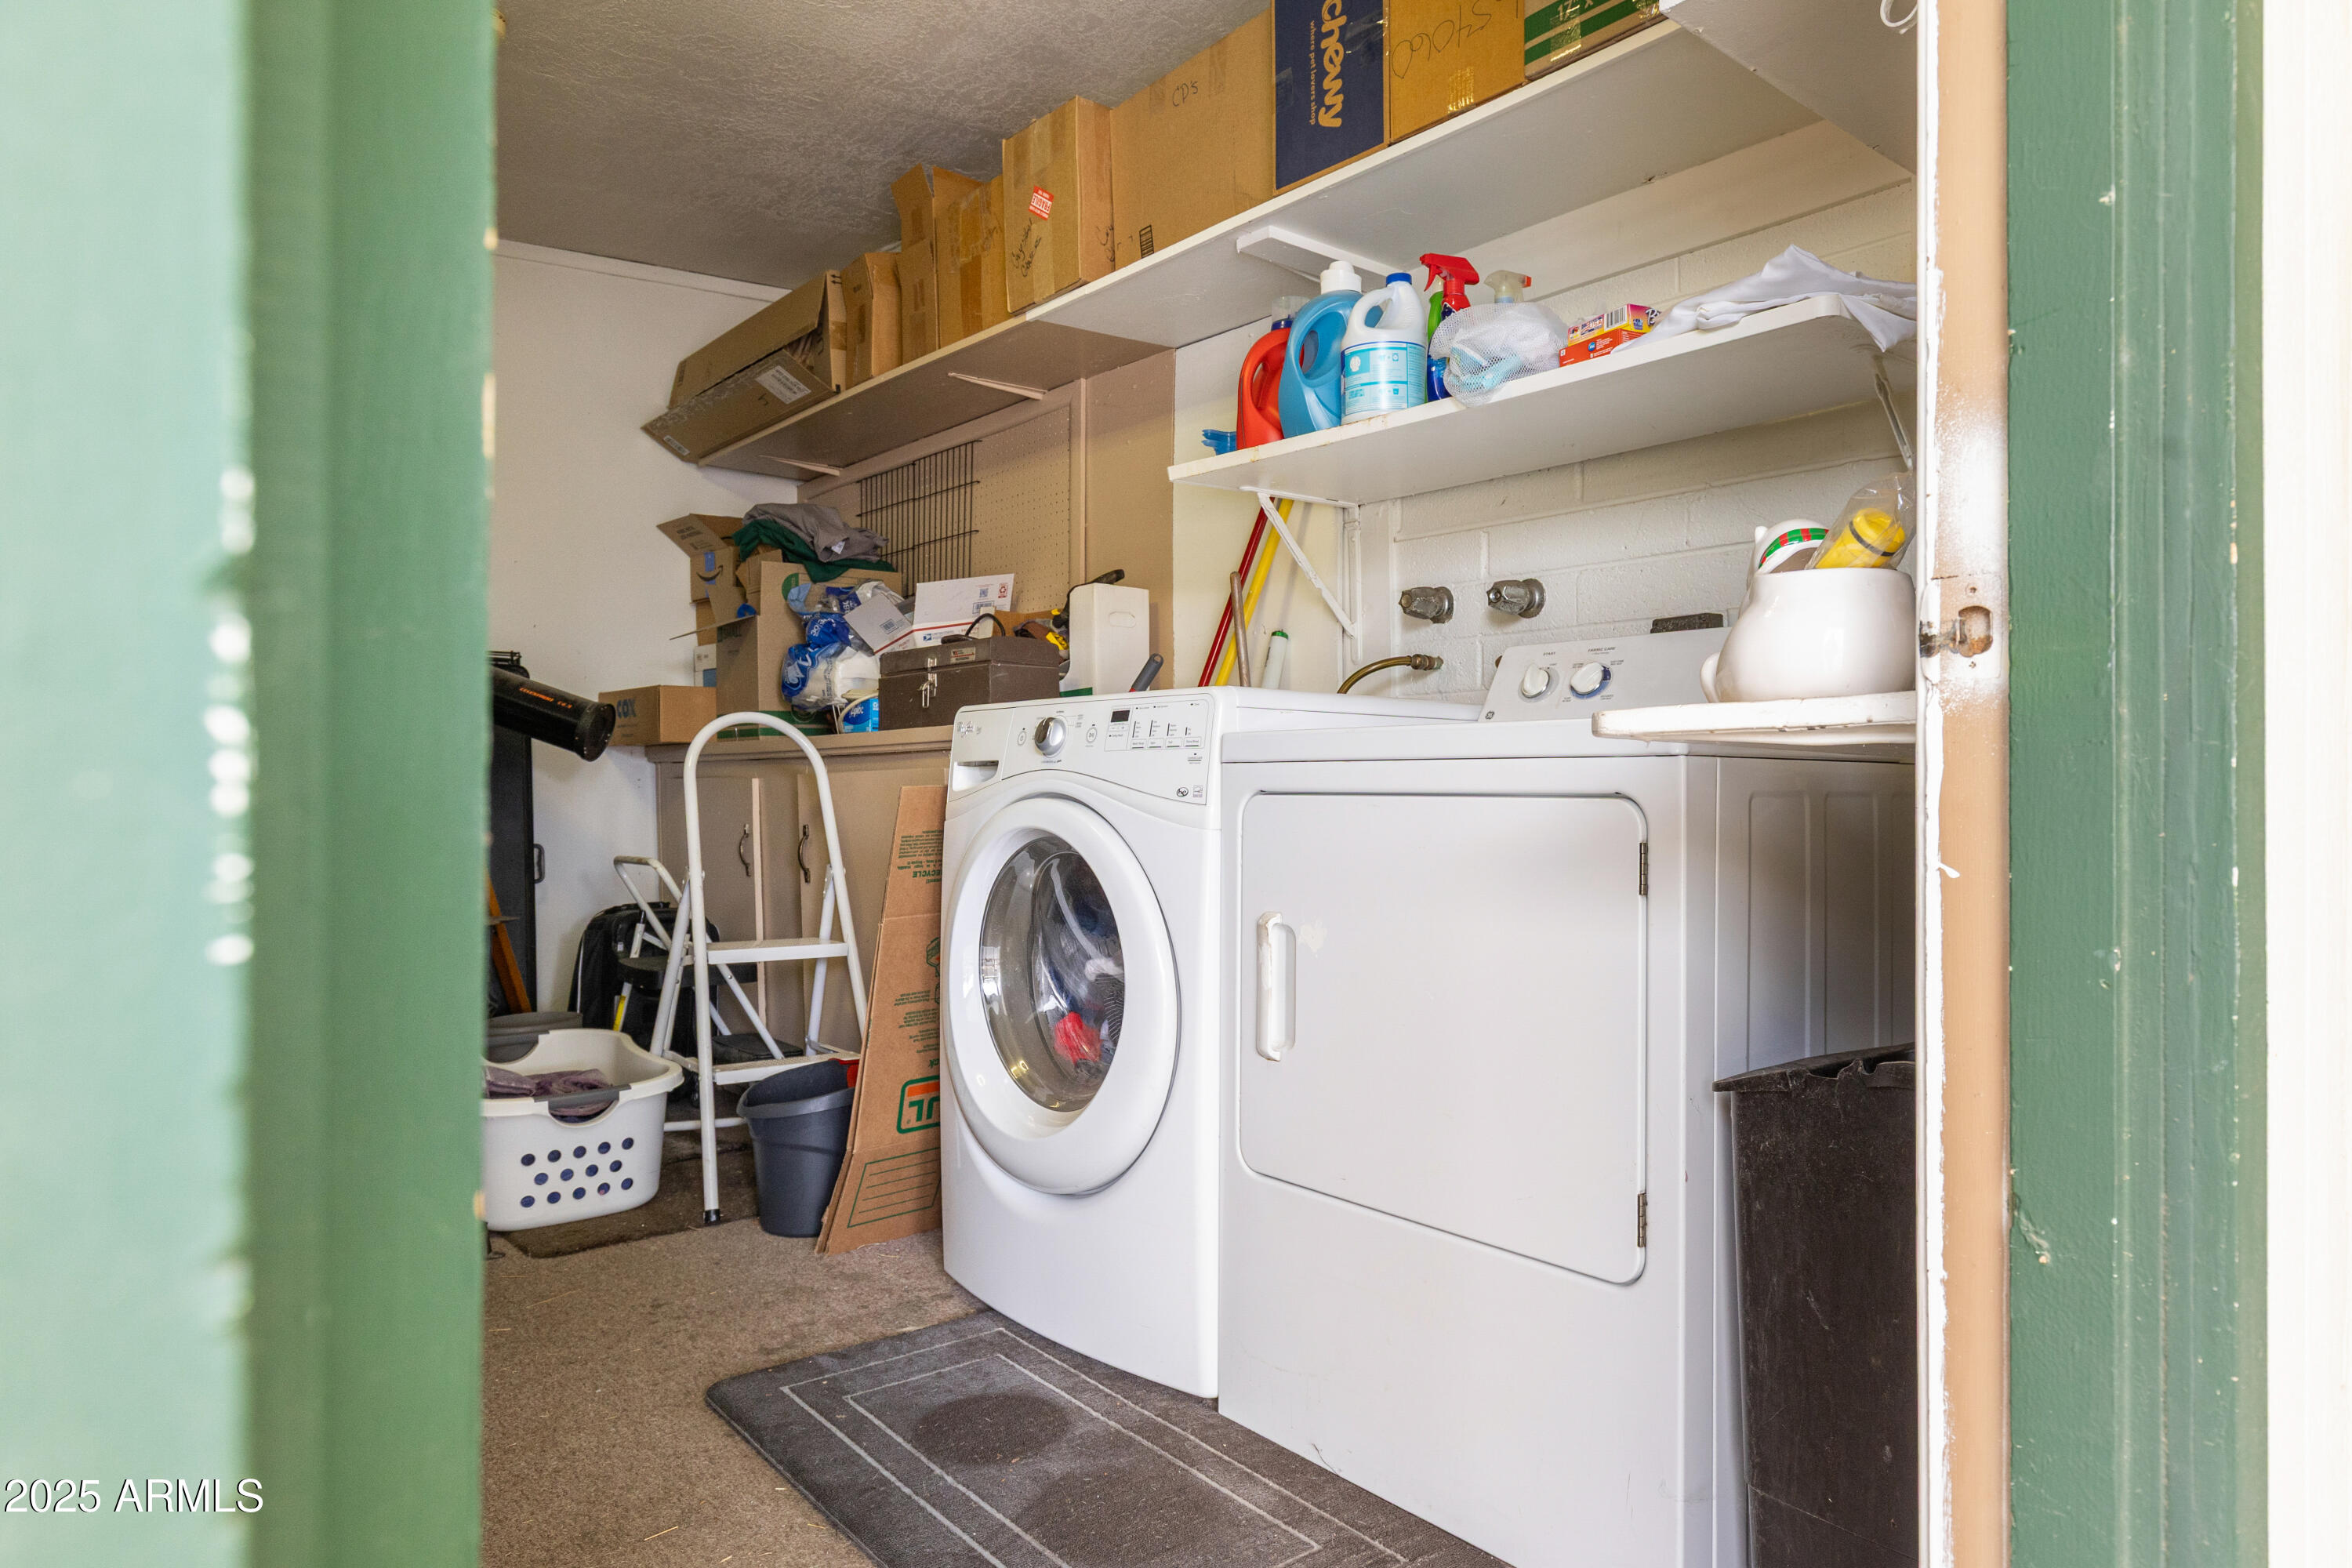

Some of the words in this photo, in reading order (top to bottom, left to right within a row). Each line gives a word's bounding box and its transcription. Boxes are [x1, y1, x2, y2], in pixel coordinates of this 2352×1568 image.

[1308, 52, 1317, 69] pet
[1318, 0, 1348, 128] chewy
[1308, 101, 1318, 125] shop
[912, 869, 942, 878] ECYCLE
